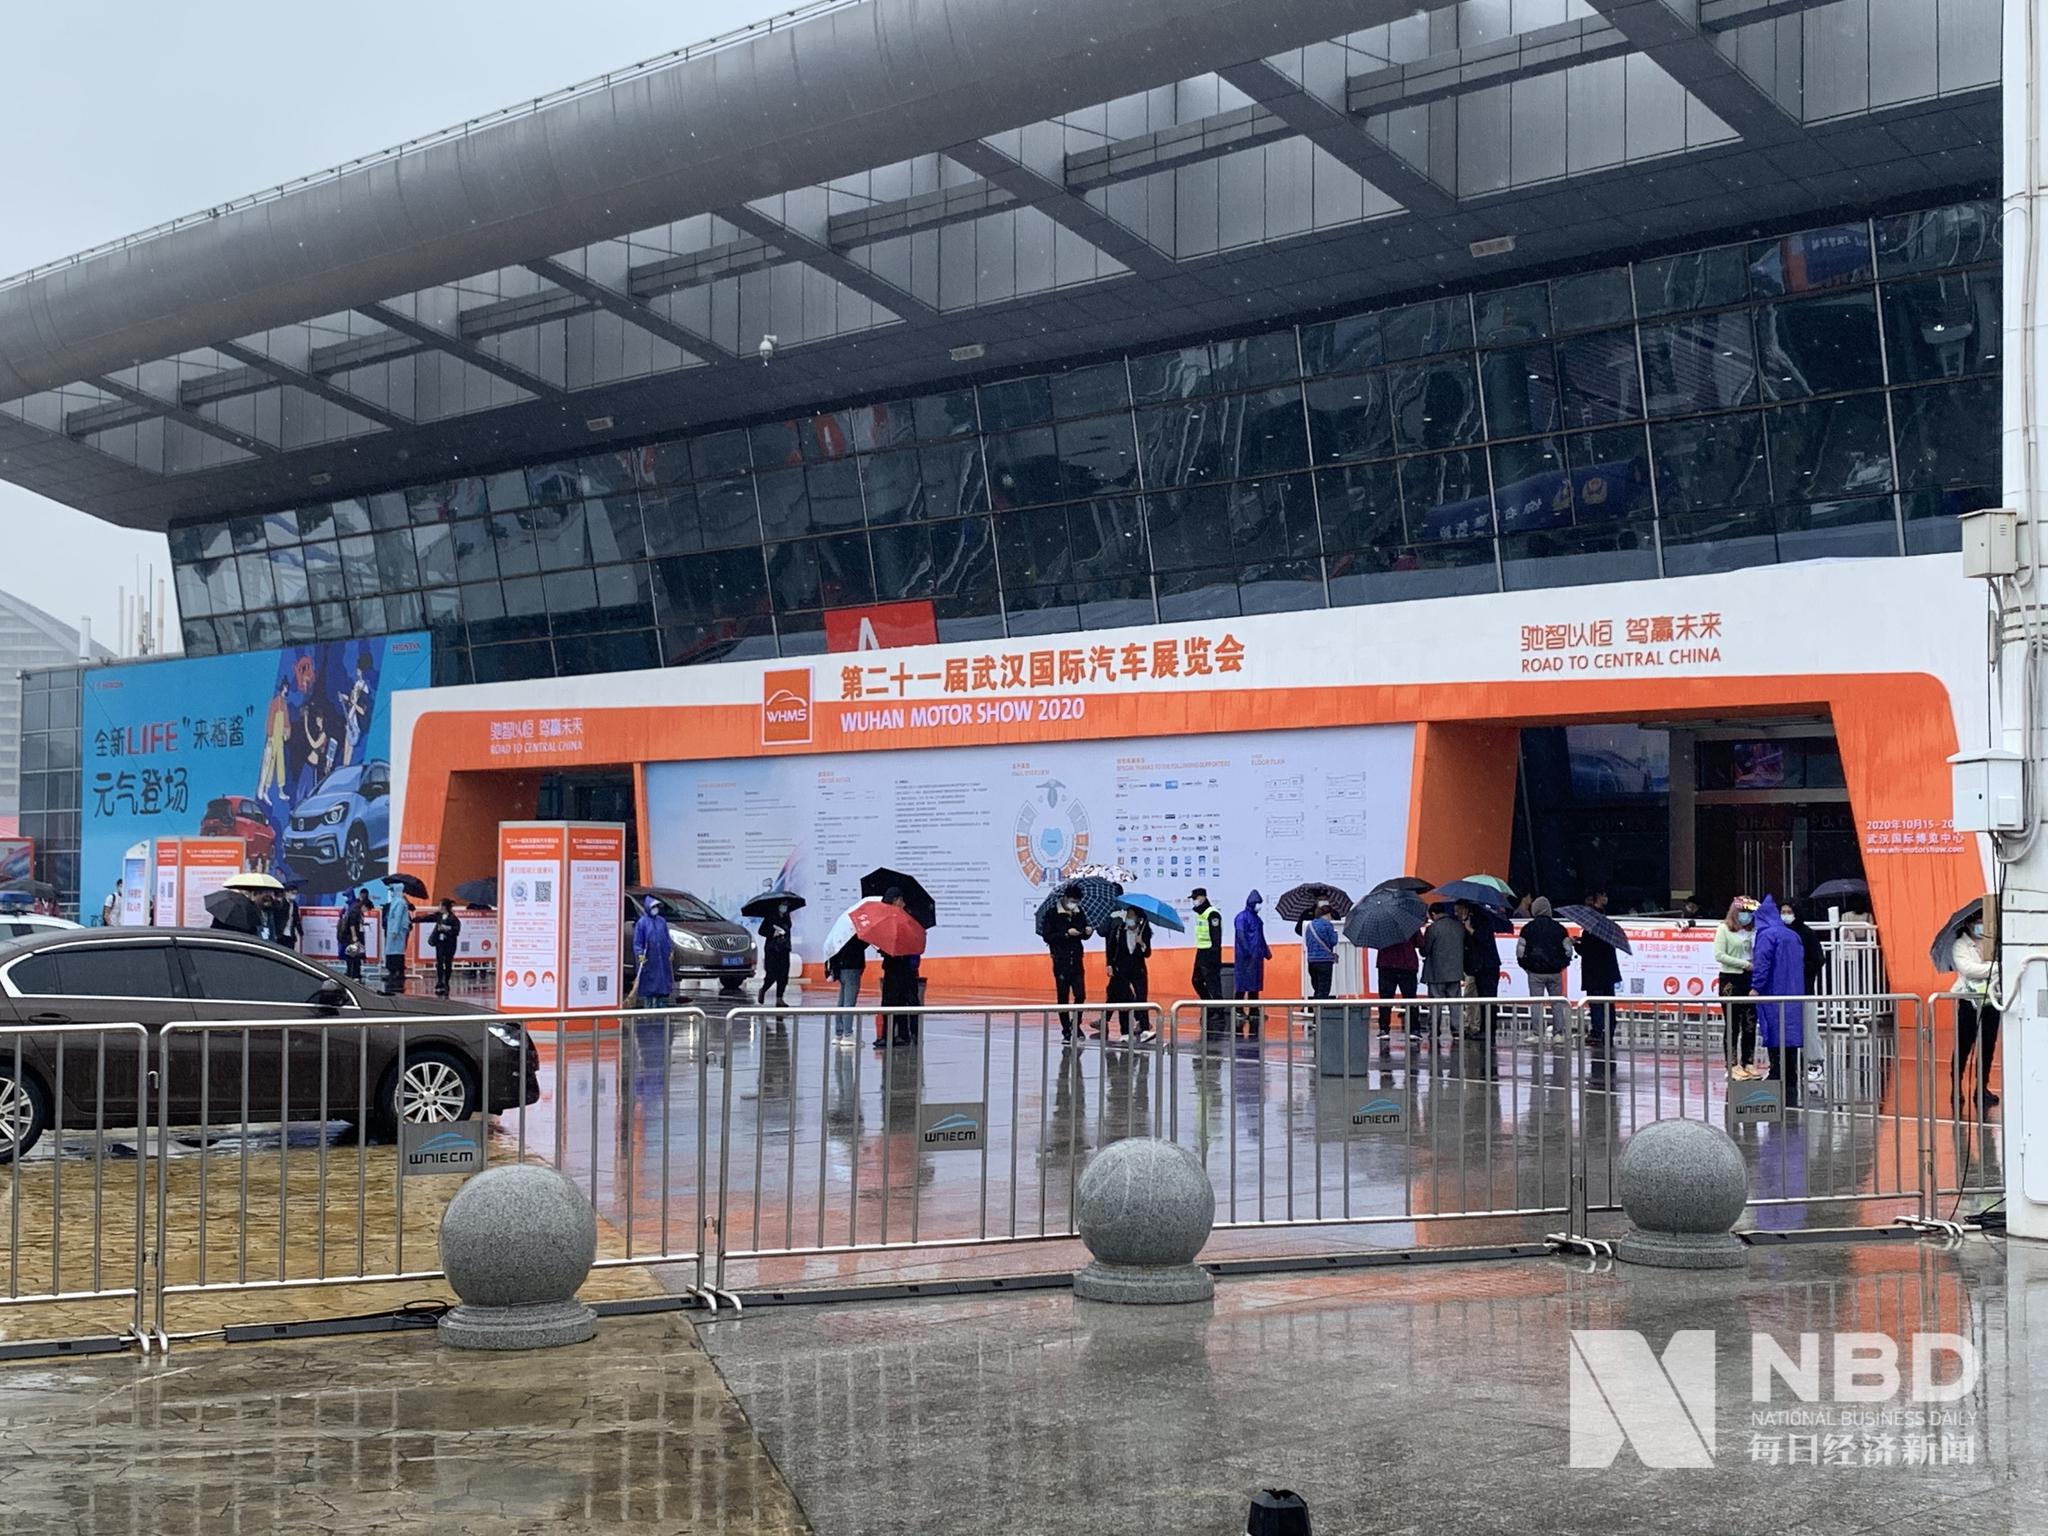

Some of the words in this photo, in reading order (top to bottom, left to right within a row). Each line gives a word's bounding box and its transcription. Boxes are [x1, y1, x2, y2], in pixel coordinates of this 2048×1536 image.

[1520, 619, 1613, 652] 驰智以恒
[1626, 612, 1722, 644] 驾赢未来
[840, 633, 1245, 700] 第二十一届武汉国际汽车展览会
[1521, 656, 1563, 673] ROAD
[1568, 655, 1589, 670] TO
[1594, 651, 1664, 669] CENTRAL
[1669, 647, 1722, 664] CHINA
[766, 709, 807, 723] WHMS
[840, 709, 904, 733] WUHAN
[910, 704, 973, 727] MOTOR
[977, 699, 1033, 725] SHOW
[1038, 697, 1086, 722] 2020
[524, 742, 557, 753] CENTRAL
[558, 740, 583, 752] CHINA
[93, 767, 189, 818] 元气登场
[1866, 832, 1965, 845] 武汉国际博览中心
[1866, 845, 1965, 854] www.wh-motorshow.com
